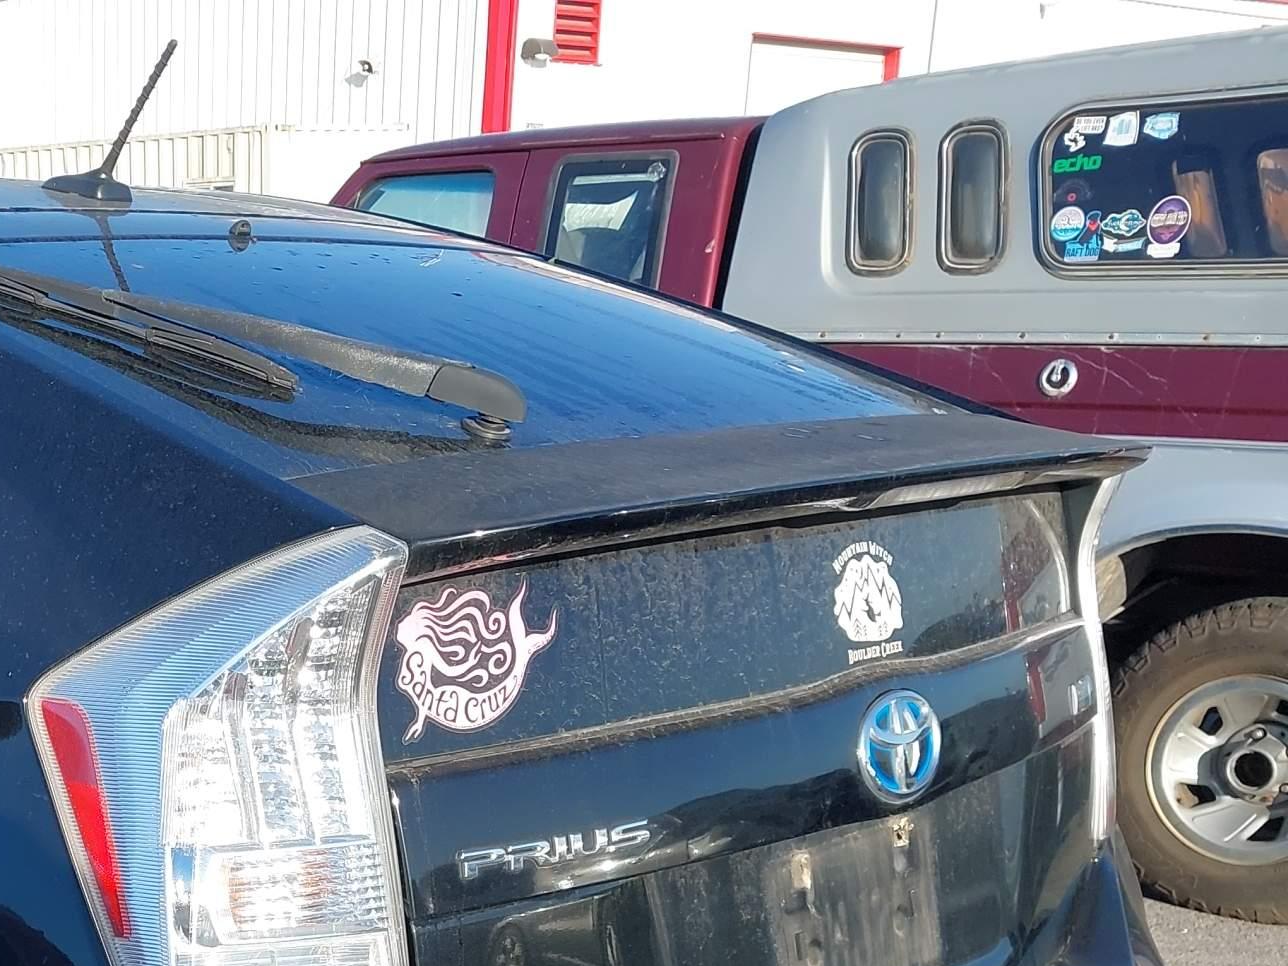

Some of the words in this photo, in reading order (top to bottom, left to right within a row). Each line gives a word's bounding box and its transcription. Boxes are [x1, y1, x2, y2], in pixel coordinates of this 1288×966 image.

[1053, 154, 1102, 173] echo
[1065, 247, 1084, 257] RAFT
[1085, 246, 1099, 257] DOG
[401, 652, 459, 723] Santa
[456, 819, 651, 879] PRIUS
